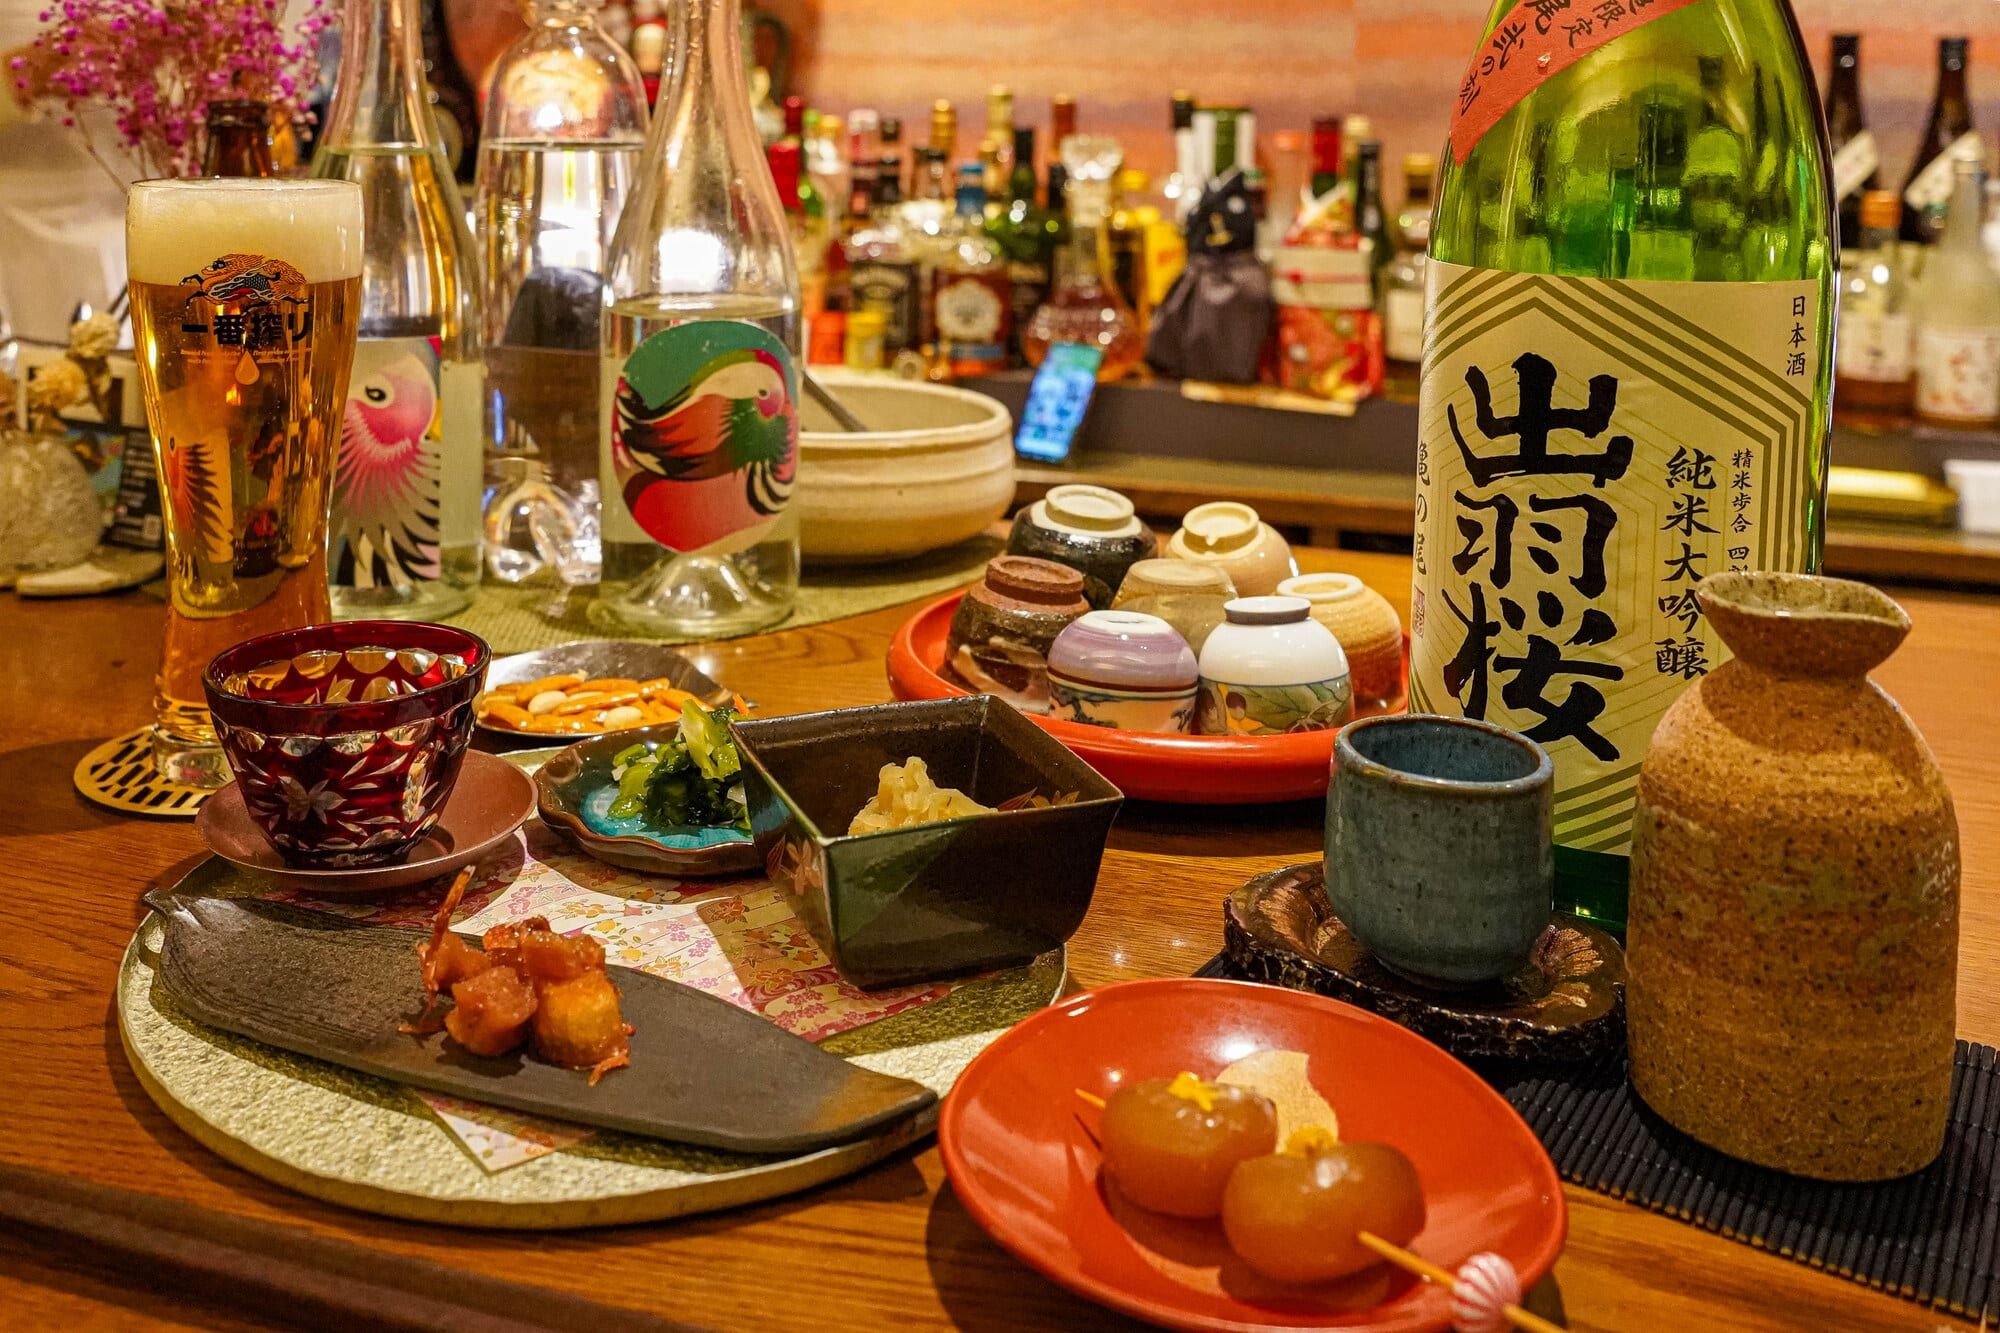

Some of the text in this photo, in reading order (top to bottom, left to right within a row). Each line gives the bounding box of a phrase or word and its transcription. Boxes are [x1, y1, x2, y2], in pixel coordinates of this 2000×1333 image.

[181, 311, 311, 347] 一番搾り
[1786, 295, 1806, 377] 日本酒
[1413, 440, 1430, 576] 亀の尾
[1730, 447, 1754, 534] 精米歩合
[1441, 352, 1634, 761] 出羽桜
